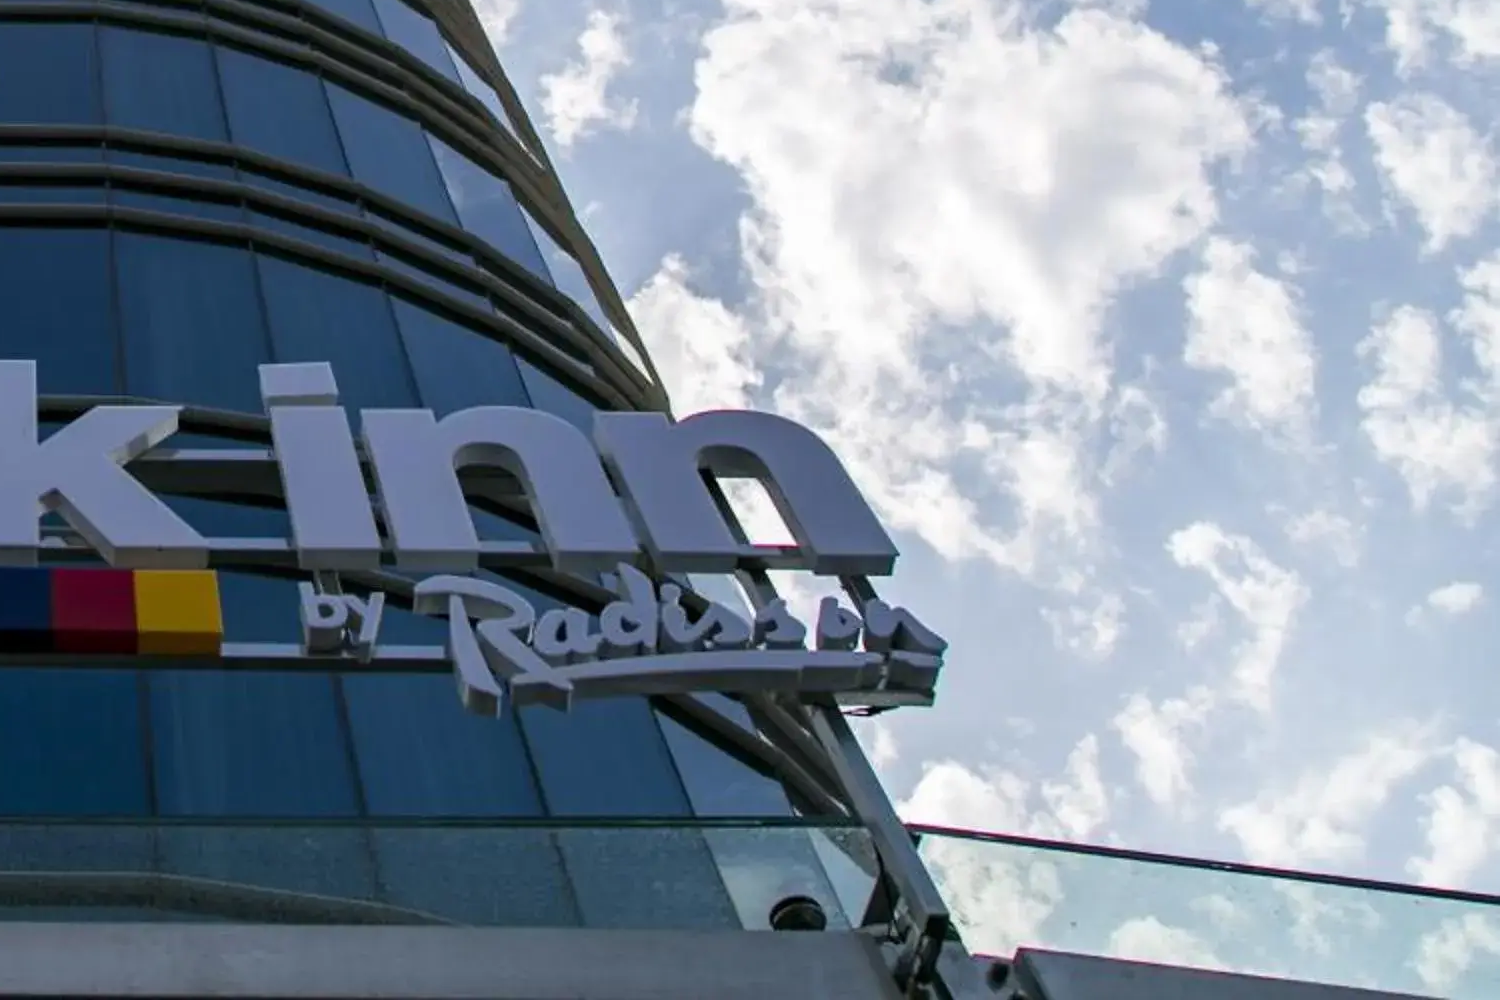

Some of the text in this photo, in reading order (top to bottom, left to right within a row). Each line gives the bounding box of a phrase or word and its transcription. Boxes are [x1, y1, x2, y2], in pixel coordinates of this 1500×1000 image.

[258, 361, 899, 575] inn
[300, 563, 948, 717] by Radisson
